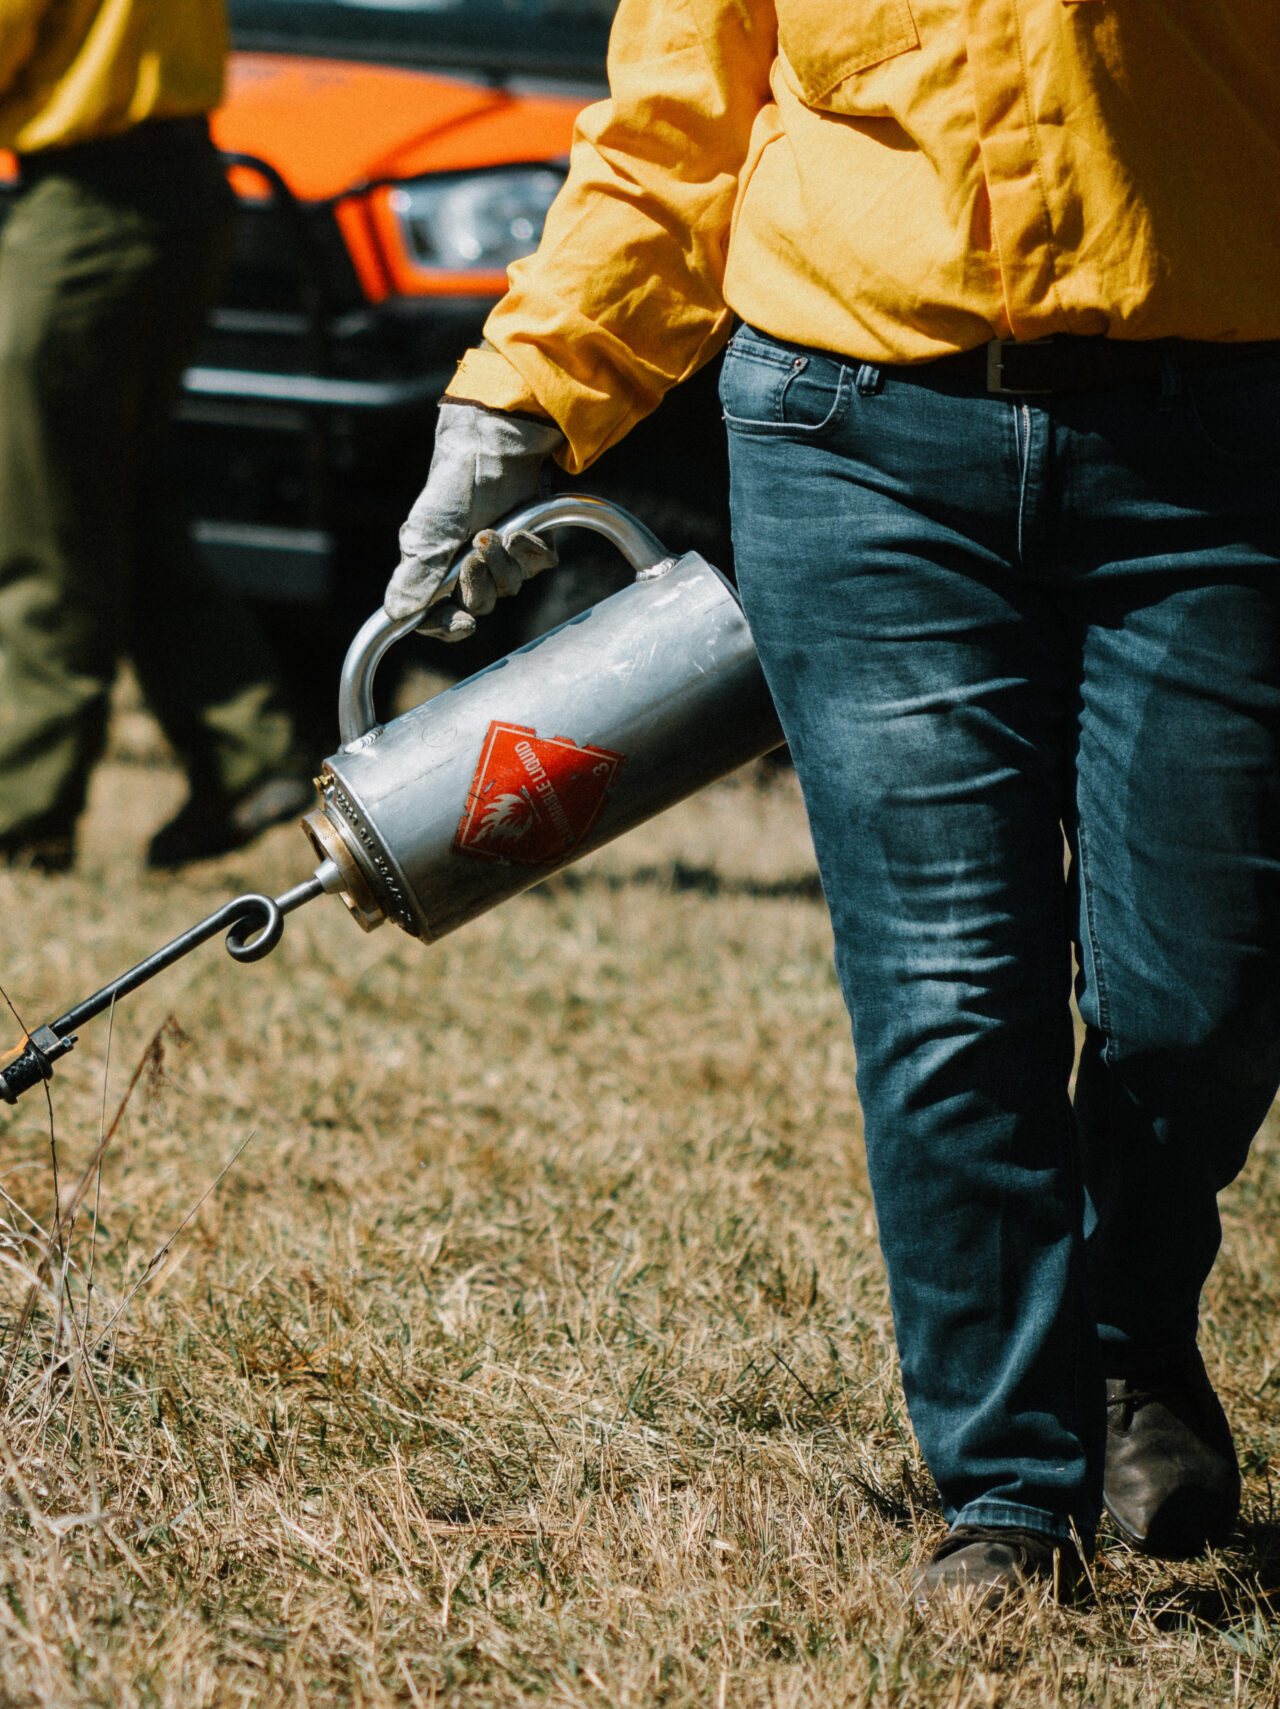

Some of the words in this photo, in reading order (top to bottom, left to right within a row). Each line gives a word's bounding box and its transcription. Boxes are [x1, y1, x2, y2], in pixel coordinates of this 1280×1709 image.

[513, 740, 548, 783] LIQUID
[592, 762, 610, 777] 3
[535, 779, 575, 842] LAMMABLE
